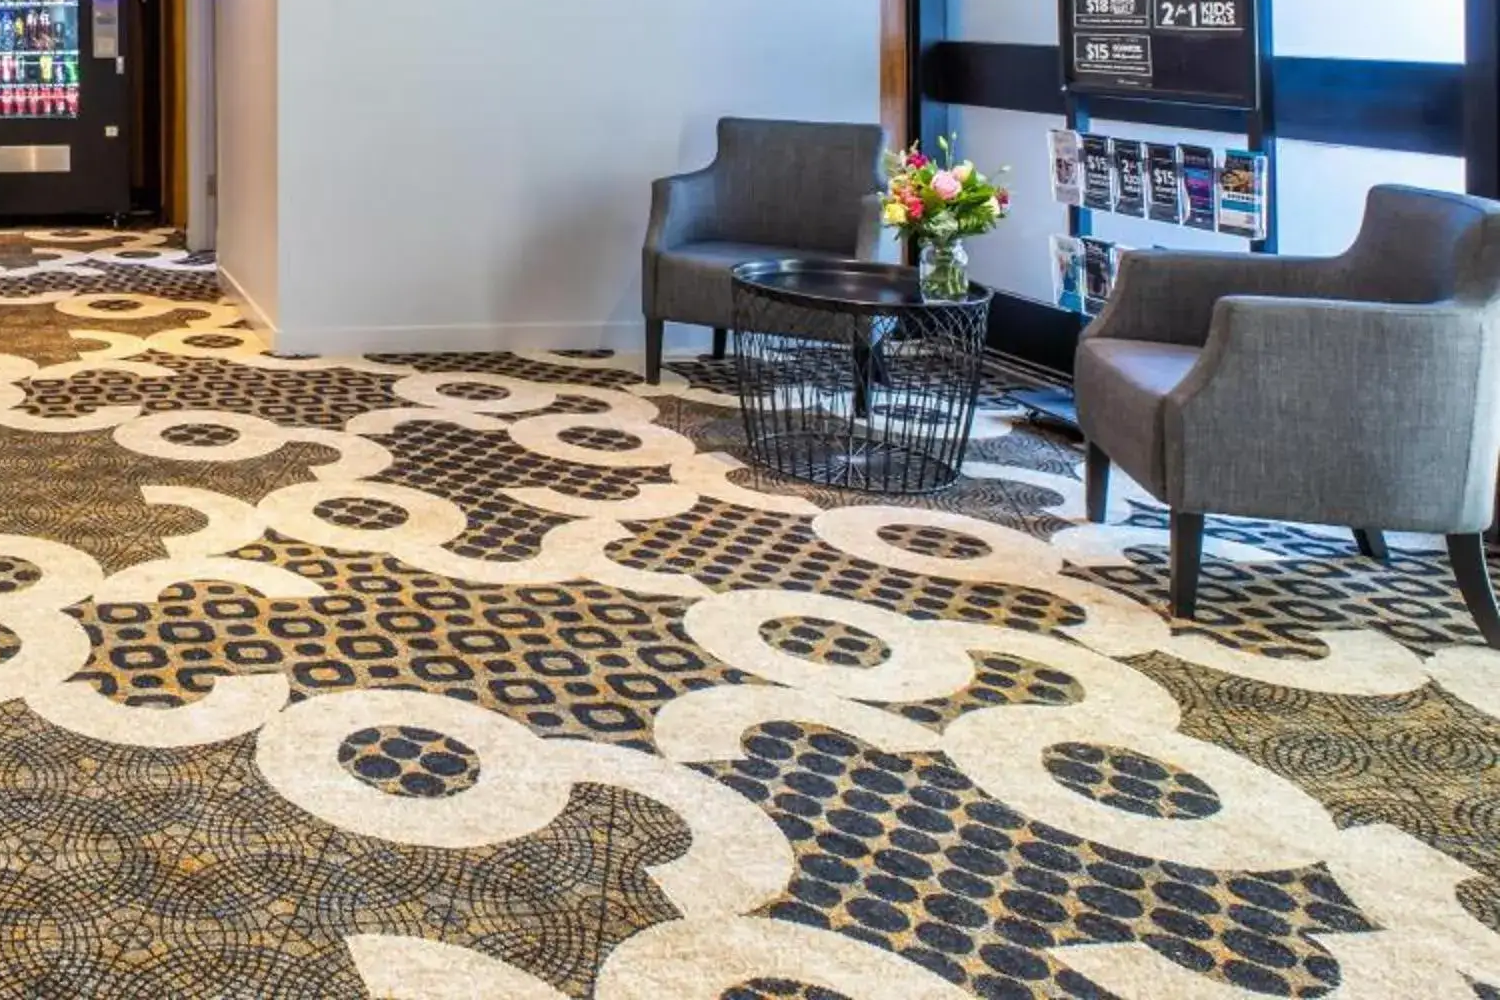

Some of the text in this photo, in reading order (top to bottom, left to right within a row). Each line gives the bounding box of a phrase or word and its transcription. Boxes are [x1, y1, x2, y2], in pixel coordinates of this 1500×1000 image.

[1161, 1, 1174, 25] 2
[1188, 2, 1197, 27] 1
[1200, 1, 1235, 15] KIDS
[1201, 14, 1235, 25] MEALS
[1085, 42, 1109, 60] $15
[1153, 168, 1175, 185] $15
